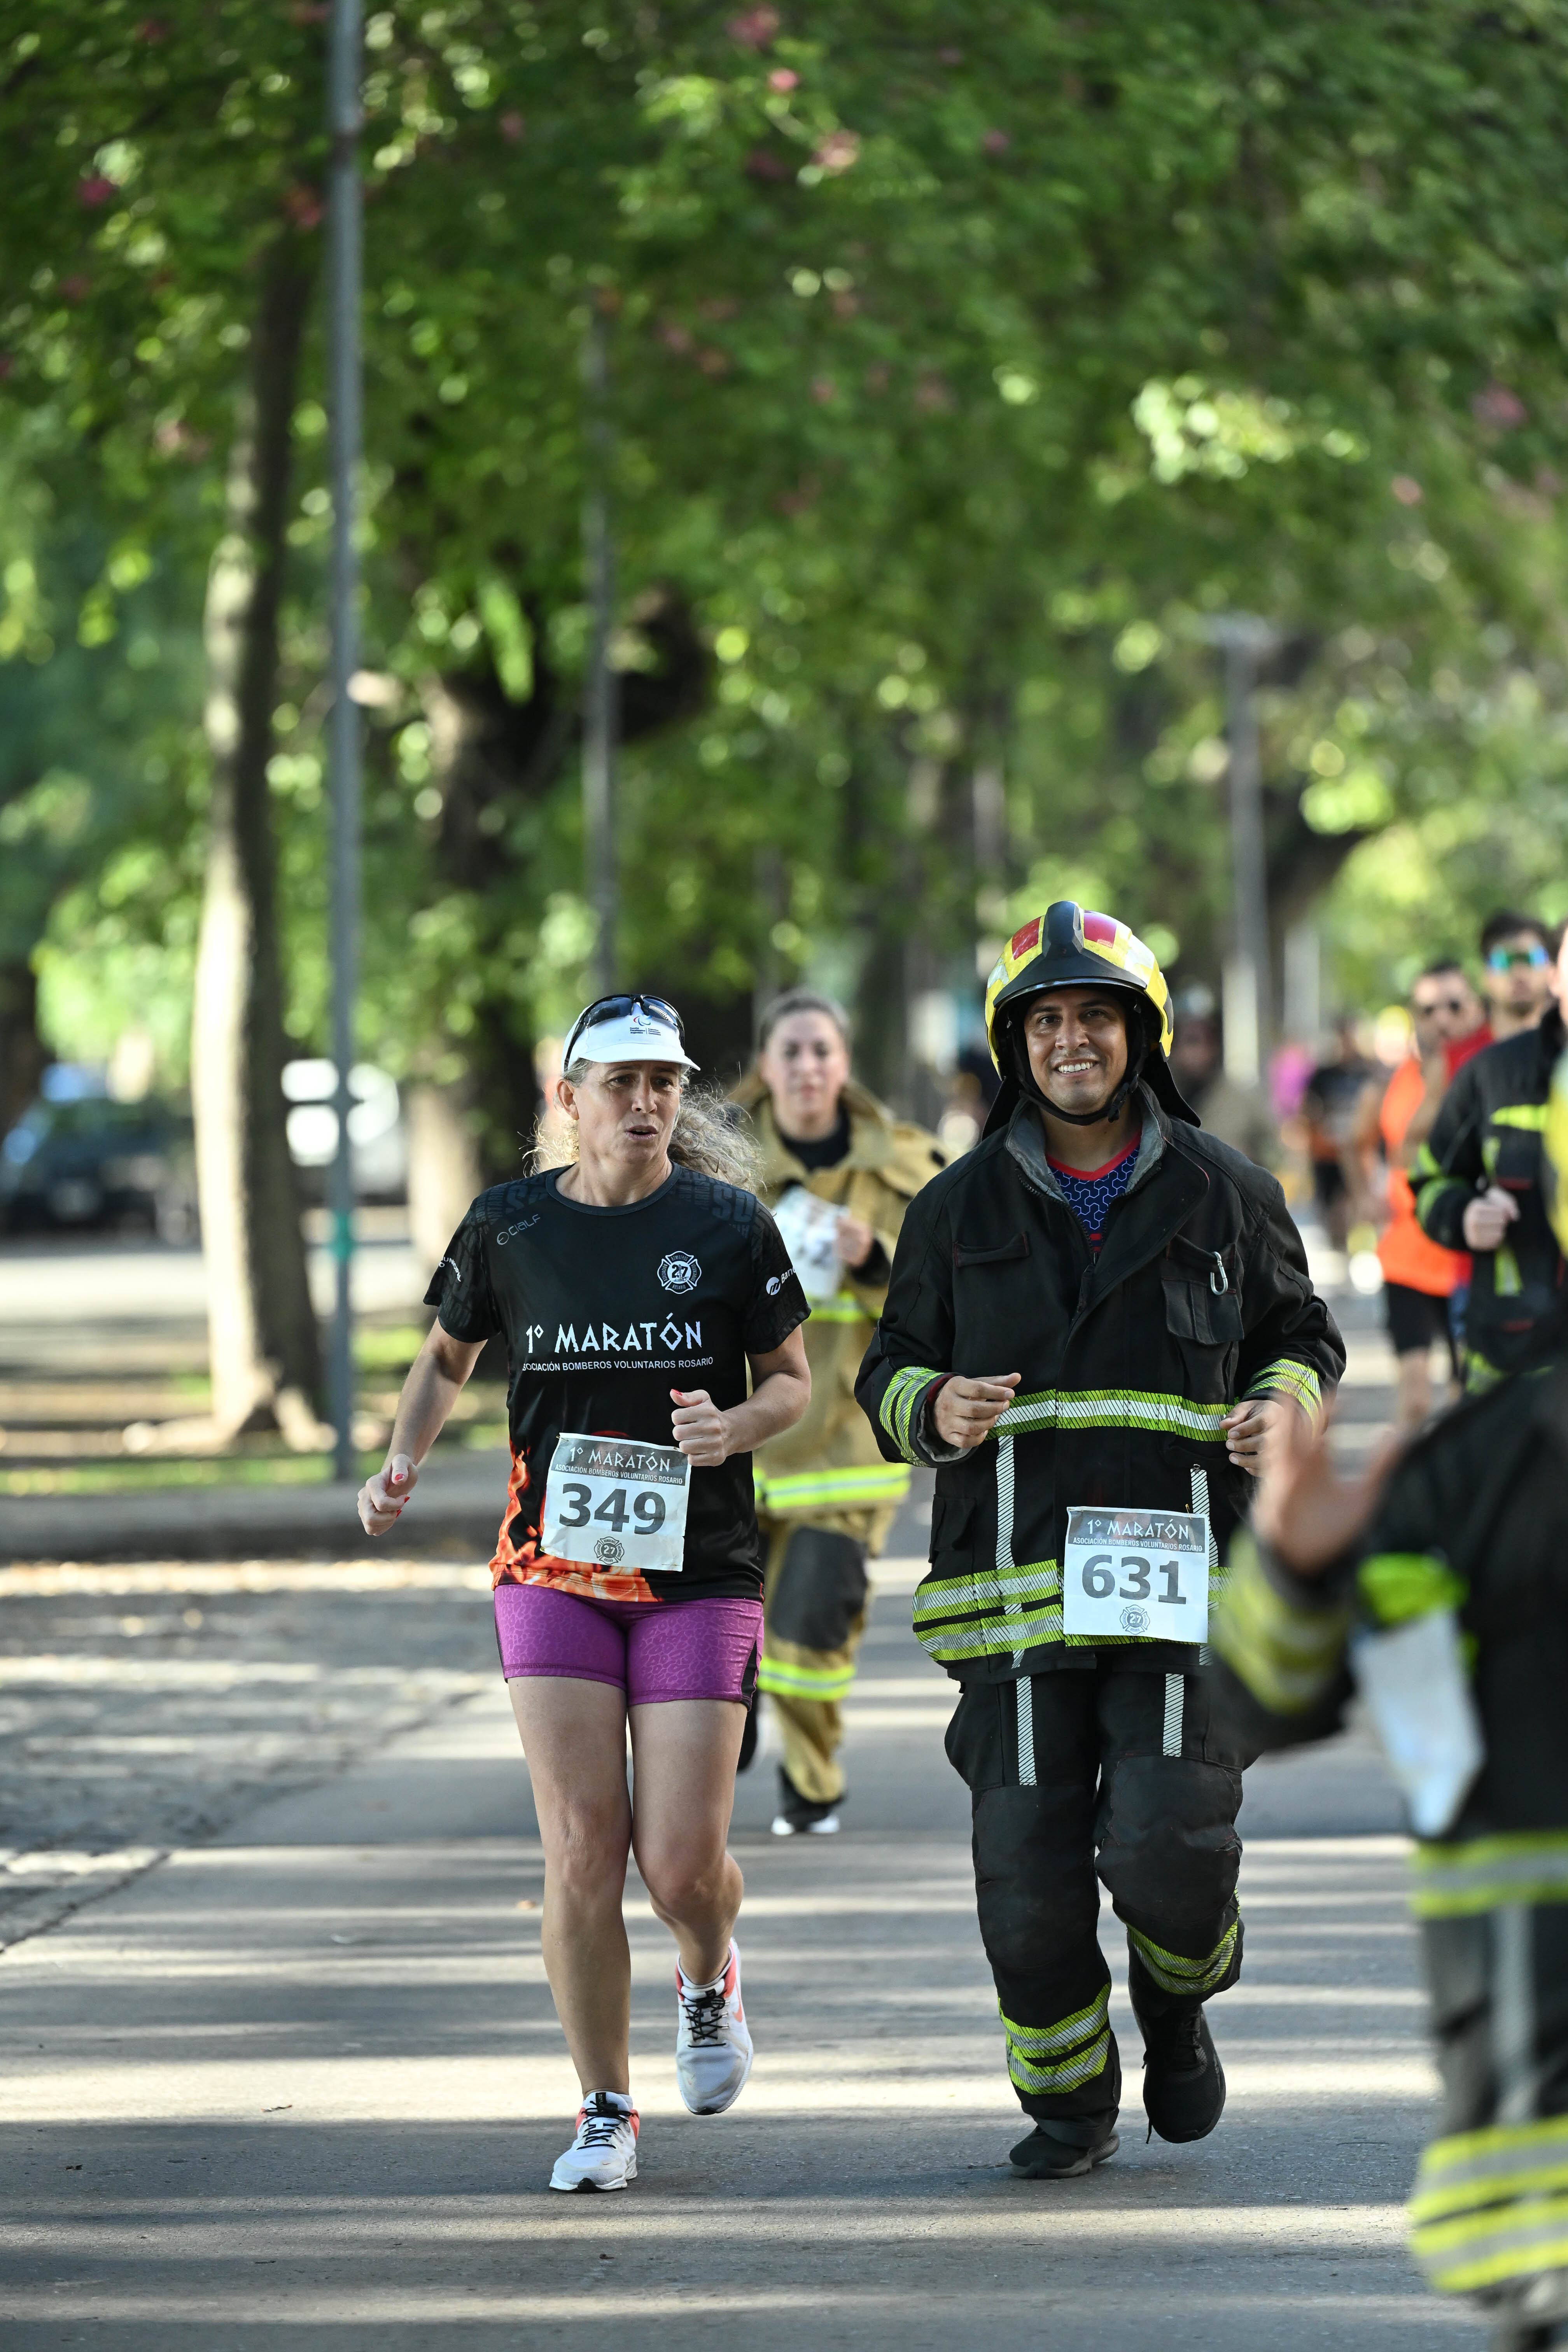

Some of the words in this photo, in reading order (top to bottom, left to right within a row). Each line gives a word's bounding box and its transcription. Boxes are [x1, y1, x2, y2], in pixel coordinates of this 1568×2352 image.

[672, 1264, 688, 1279] 27
[554, 1312, 702, 1353] MARATÓN
[562, 1361, 612, 1371] BOMBEROS
[615, 1360, 676, 1369] VOLUNTARIOS
[679, 1356, 713, 1368] ROSARIO
[588, 1449, 670, 1472] MARATÓN
[555, 1464, 587, 1474] ASOCIACIÓN
[589, 1468, 619, 1478] BOMBEROS
[620, 1471, 657, 1482] VOLUNTARIOS
[658, 1476, 682, 1485] ROSARIO
[559, 1483, 666, 1535] 349
[1107, 1519, 1189, 1540] MARATÓN
[604, 1545, 616, 1554] 27
[1073, 1536, 1107, 1545] ASOCIACIÓN
[1108, 1538, 1139, 1547] BOMBEROS
[1140, 1541, 1177, 1550] VOLUNTARIOS
[1178, 1544, 1202, 1552] ROSARIO
[1082, 1554, 1186, 1605] 631
[1129, 1613, 1142, 1624] 27
